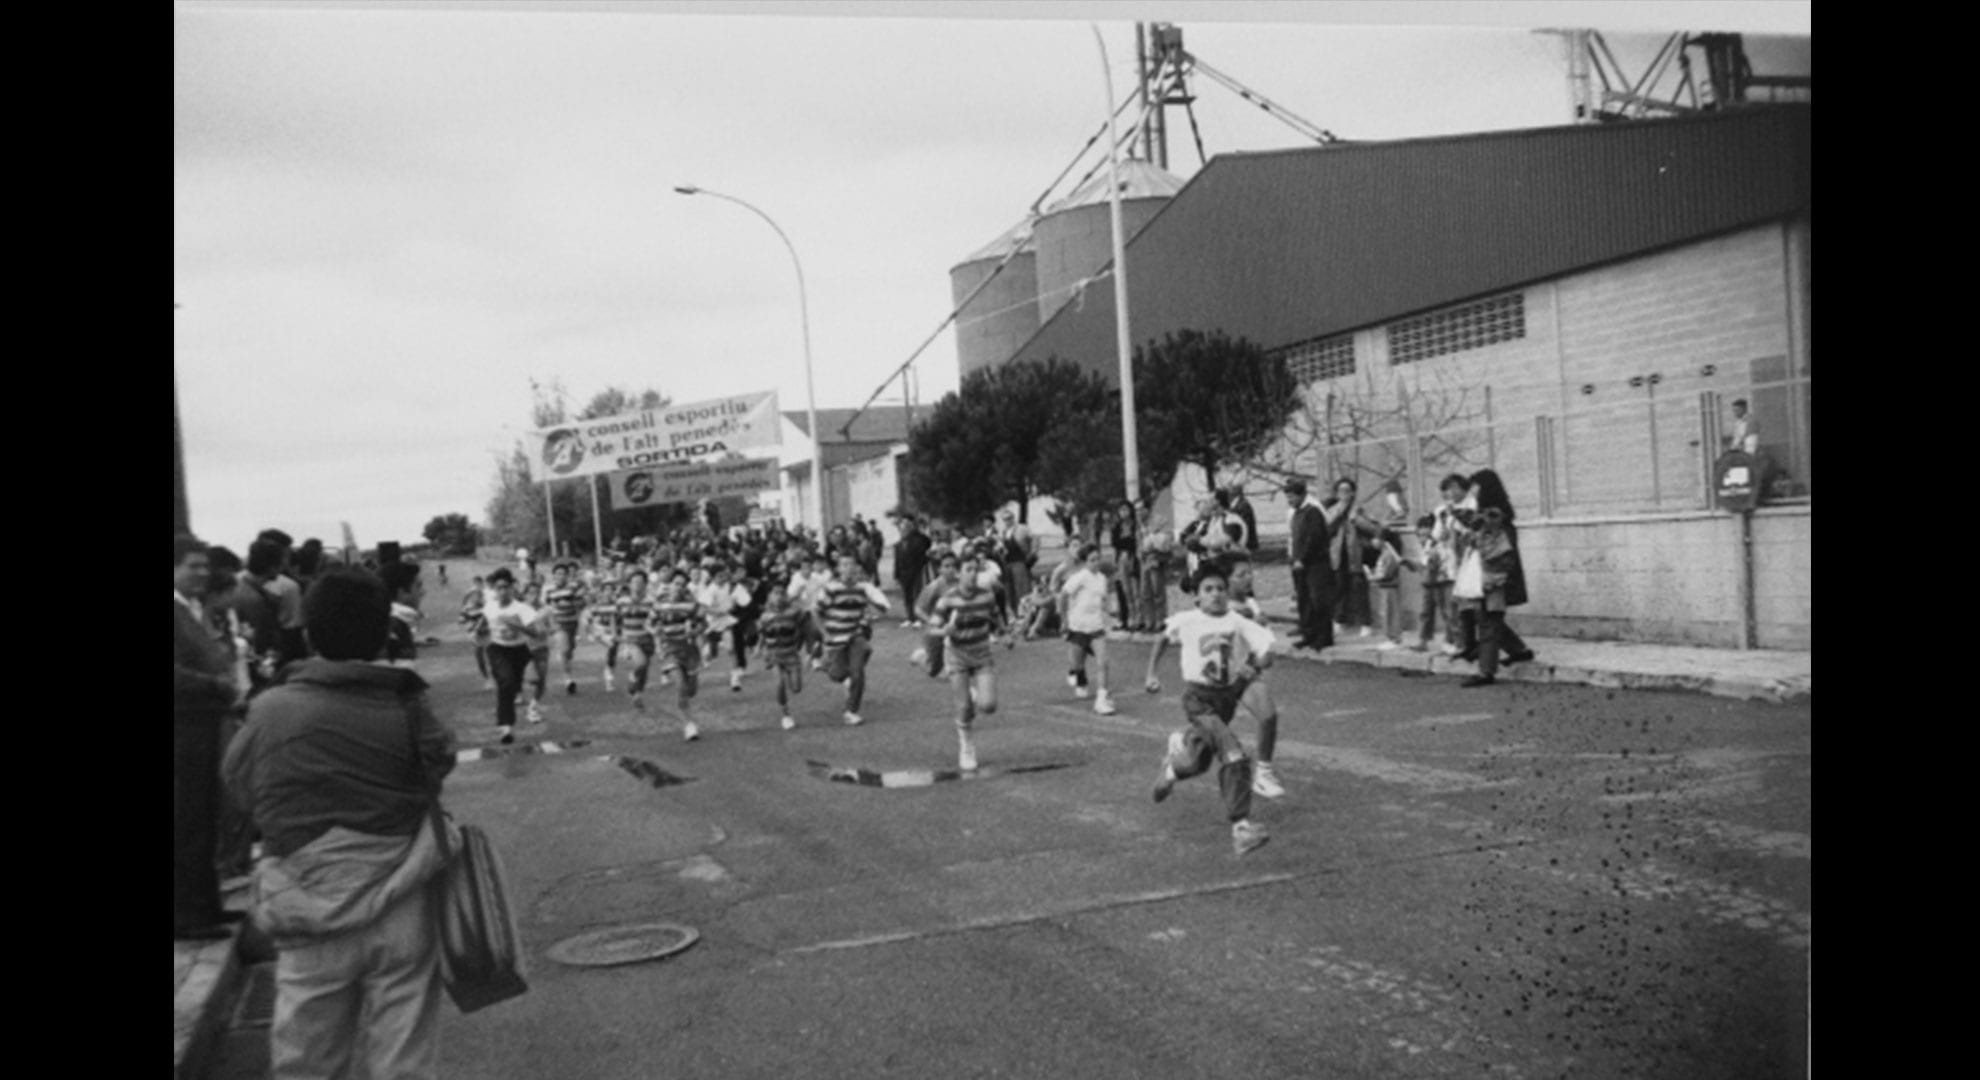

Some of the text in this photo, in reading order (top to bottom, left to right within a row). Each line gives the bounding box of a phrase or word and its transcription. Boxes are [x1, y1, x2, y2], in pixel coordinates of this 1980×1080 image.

[588, 400, 748, 437] consell esportiu
[591, 440, 614, 455] de
[616, 441, 728, 469] SORTIDA
